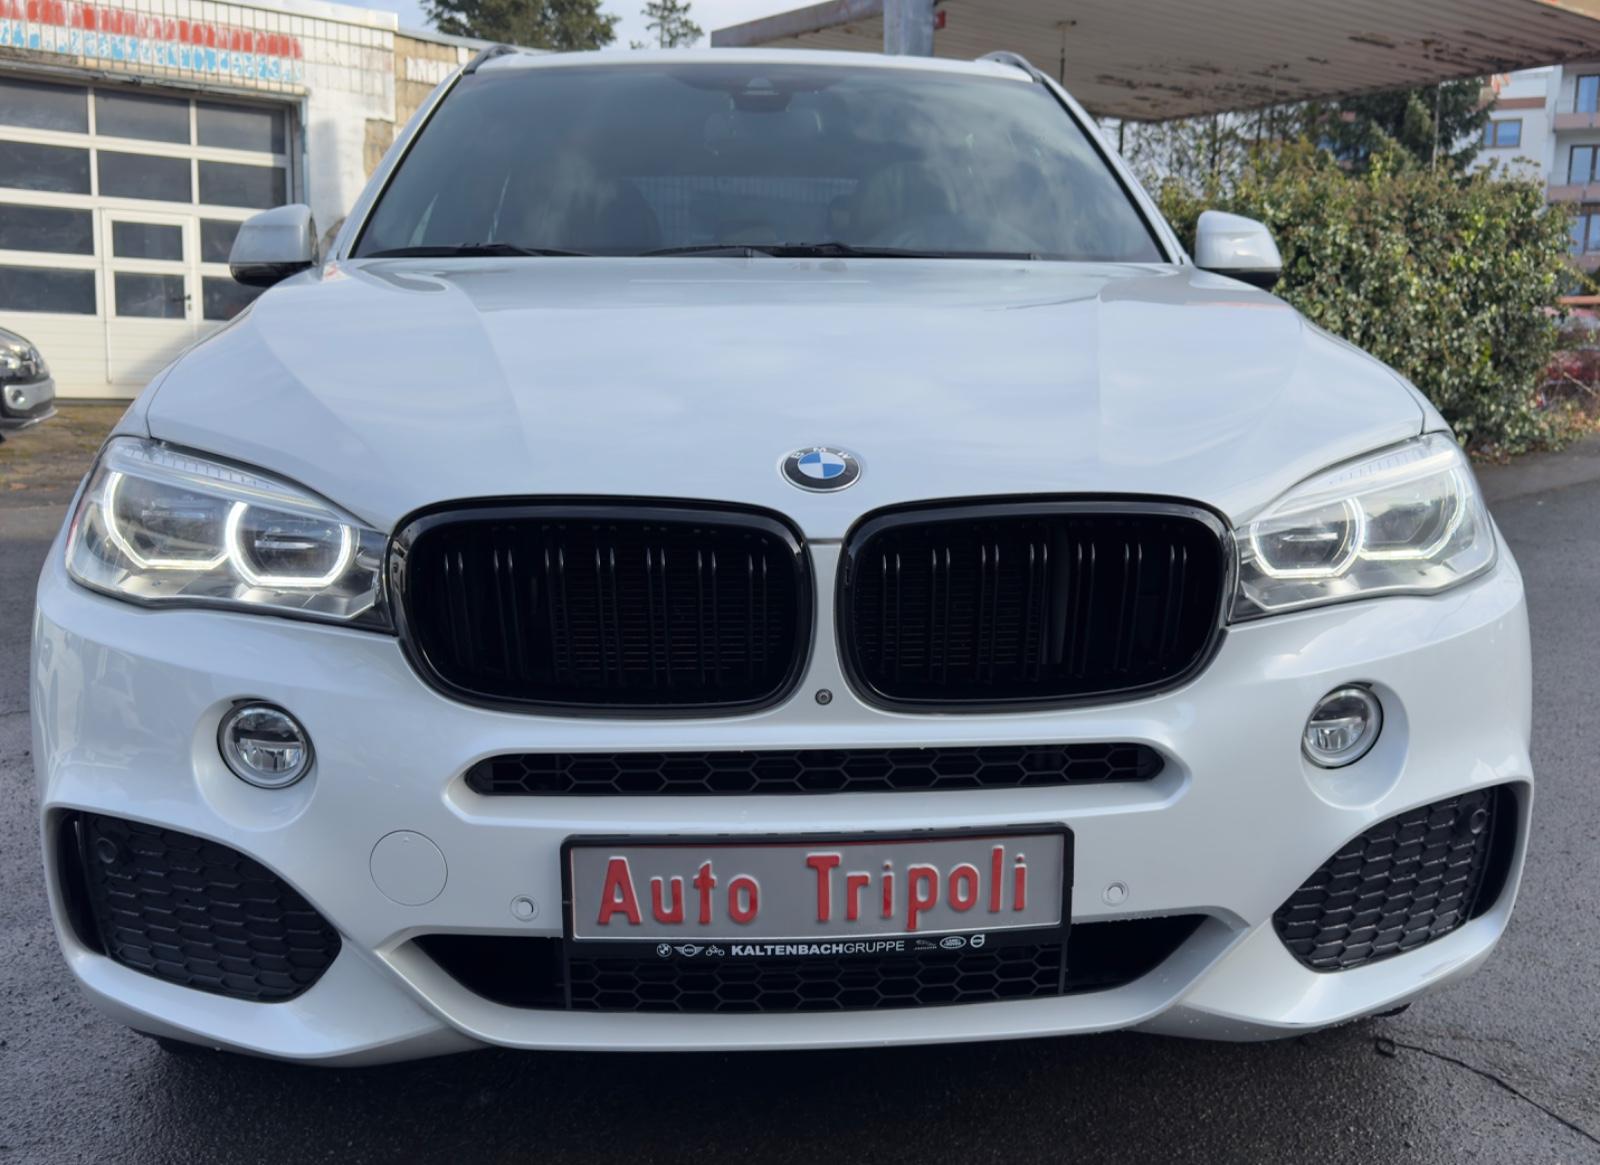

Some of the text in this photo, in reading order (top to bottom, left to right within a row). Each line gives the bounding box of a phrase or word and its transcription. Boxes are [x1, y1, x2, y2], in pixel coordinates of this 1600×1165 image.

[597, 845, 1027, 932] Auto Tripoli
[731, 940, 905, 956] KALTENBACHGRUPPE
